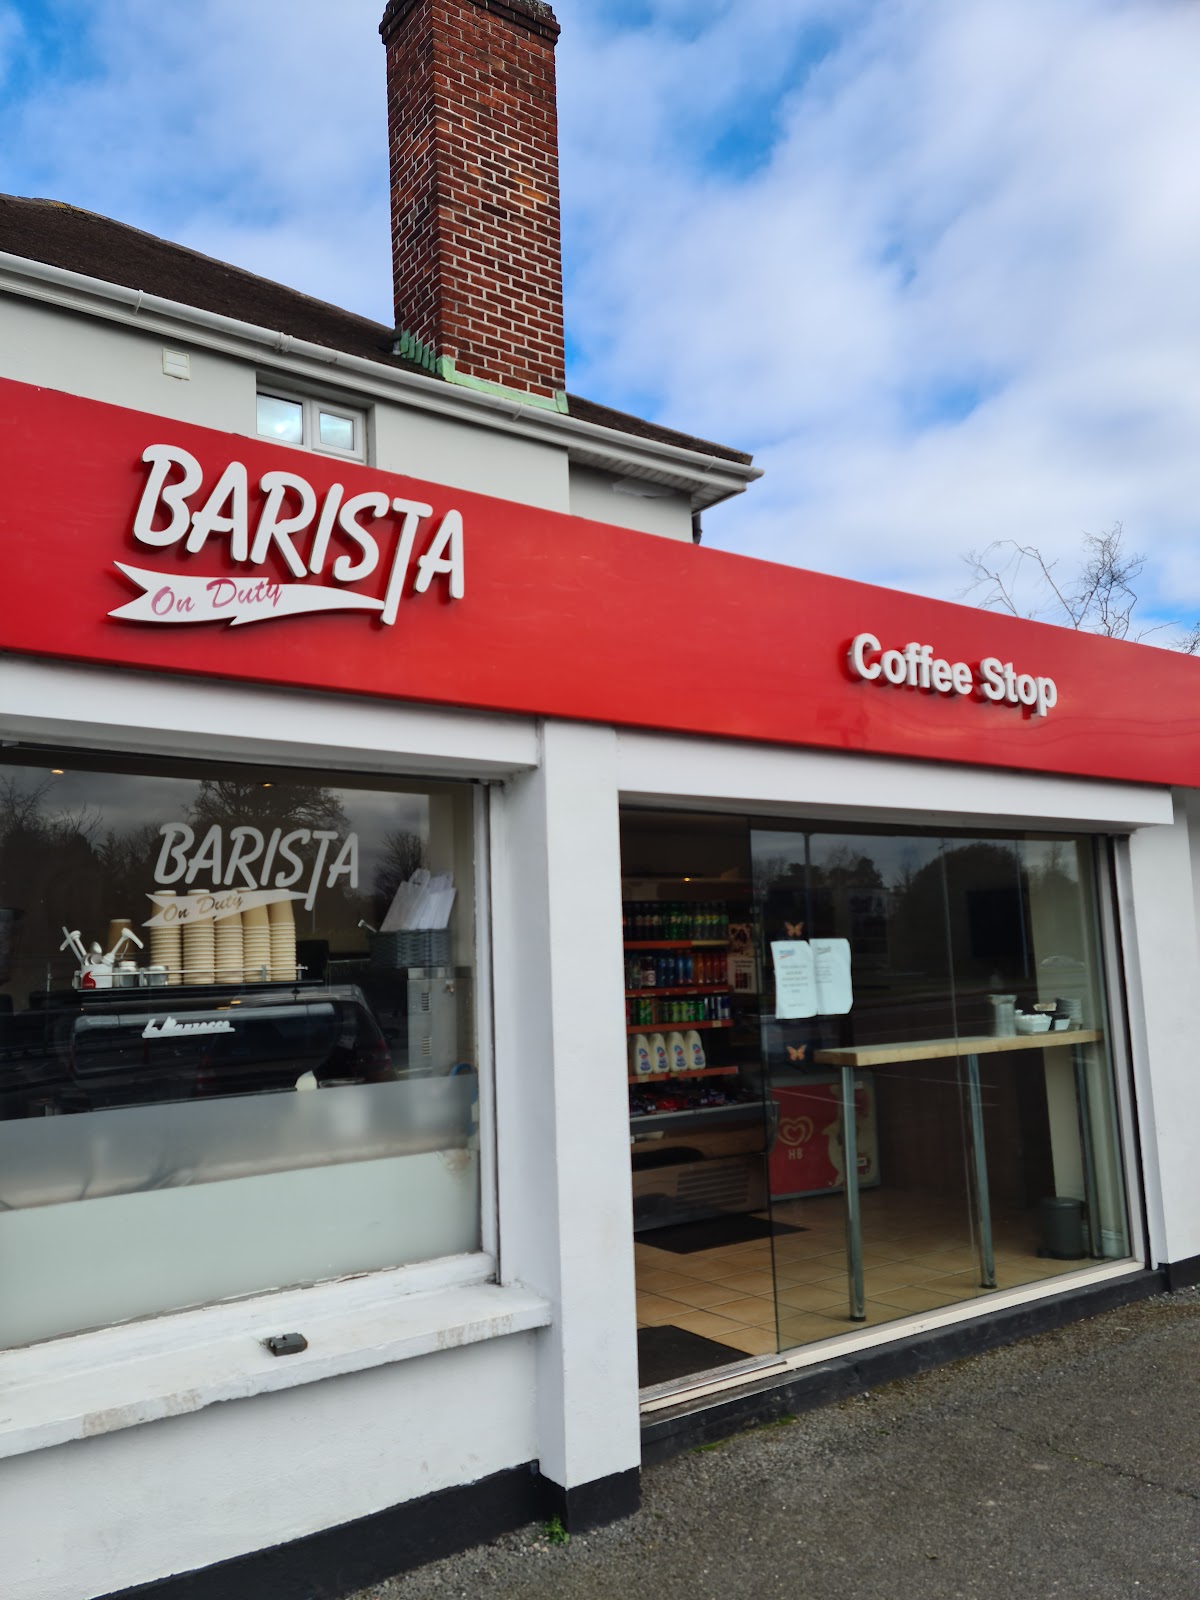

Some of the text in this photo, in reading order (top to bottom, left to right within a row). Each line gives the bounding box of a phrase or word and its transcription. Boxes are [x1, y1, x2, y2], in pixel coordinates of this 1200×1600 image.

[133, 444, 464, 625] BARISTA
[151, 579, 283, 616] On Duty
[851, 633, 1058, 717] Coffee Stop
[154, 822, 358, 911] BARISTA
[163, 894, 244, 922] On Duty
